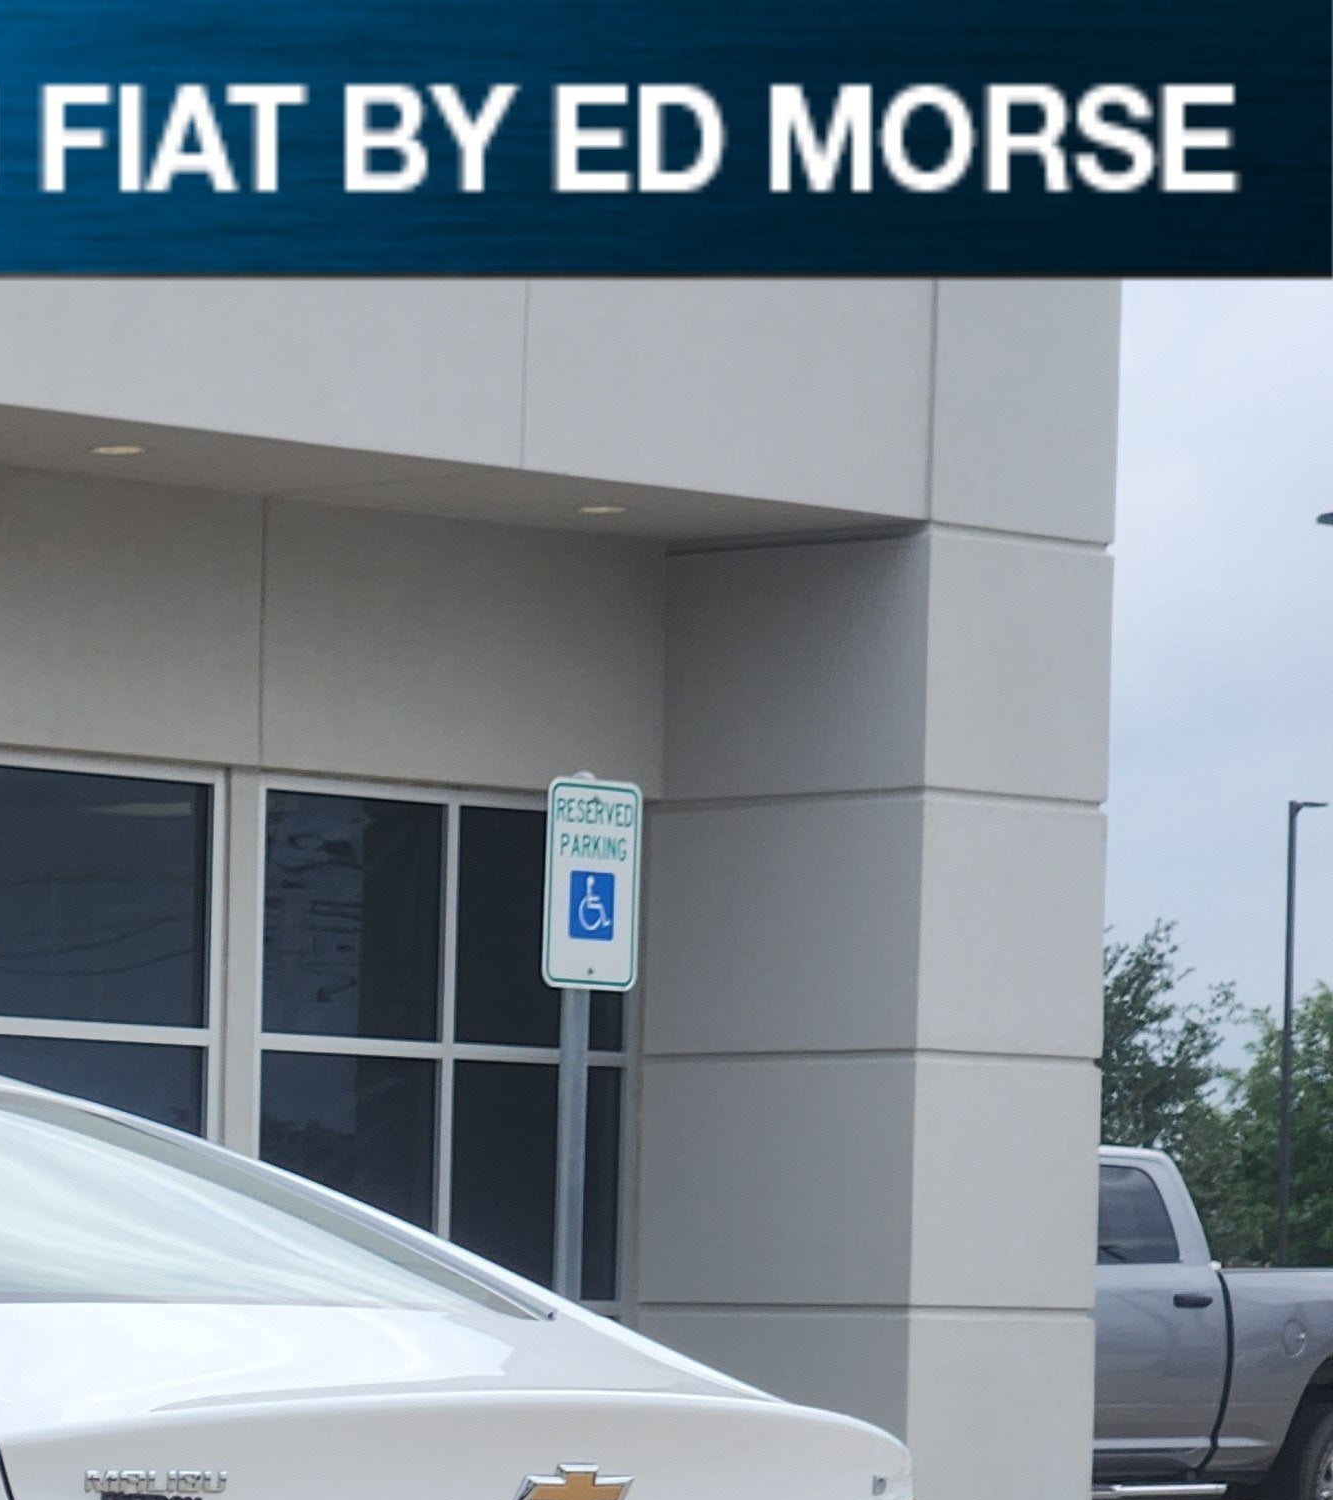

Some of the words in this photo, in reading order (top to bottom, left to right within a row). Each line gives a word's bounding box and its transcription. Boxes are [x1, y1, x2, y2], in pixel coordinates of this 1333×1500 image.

[556, 797, 632, 828] RESERVED
[560, 832, 627, 862] PARKING
[84, 1469, 228, 1494] MALIBU
